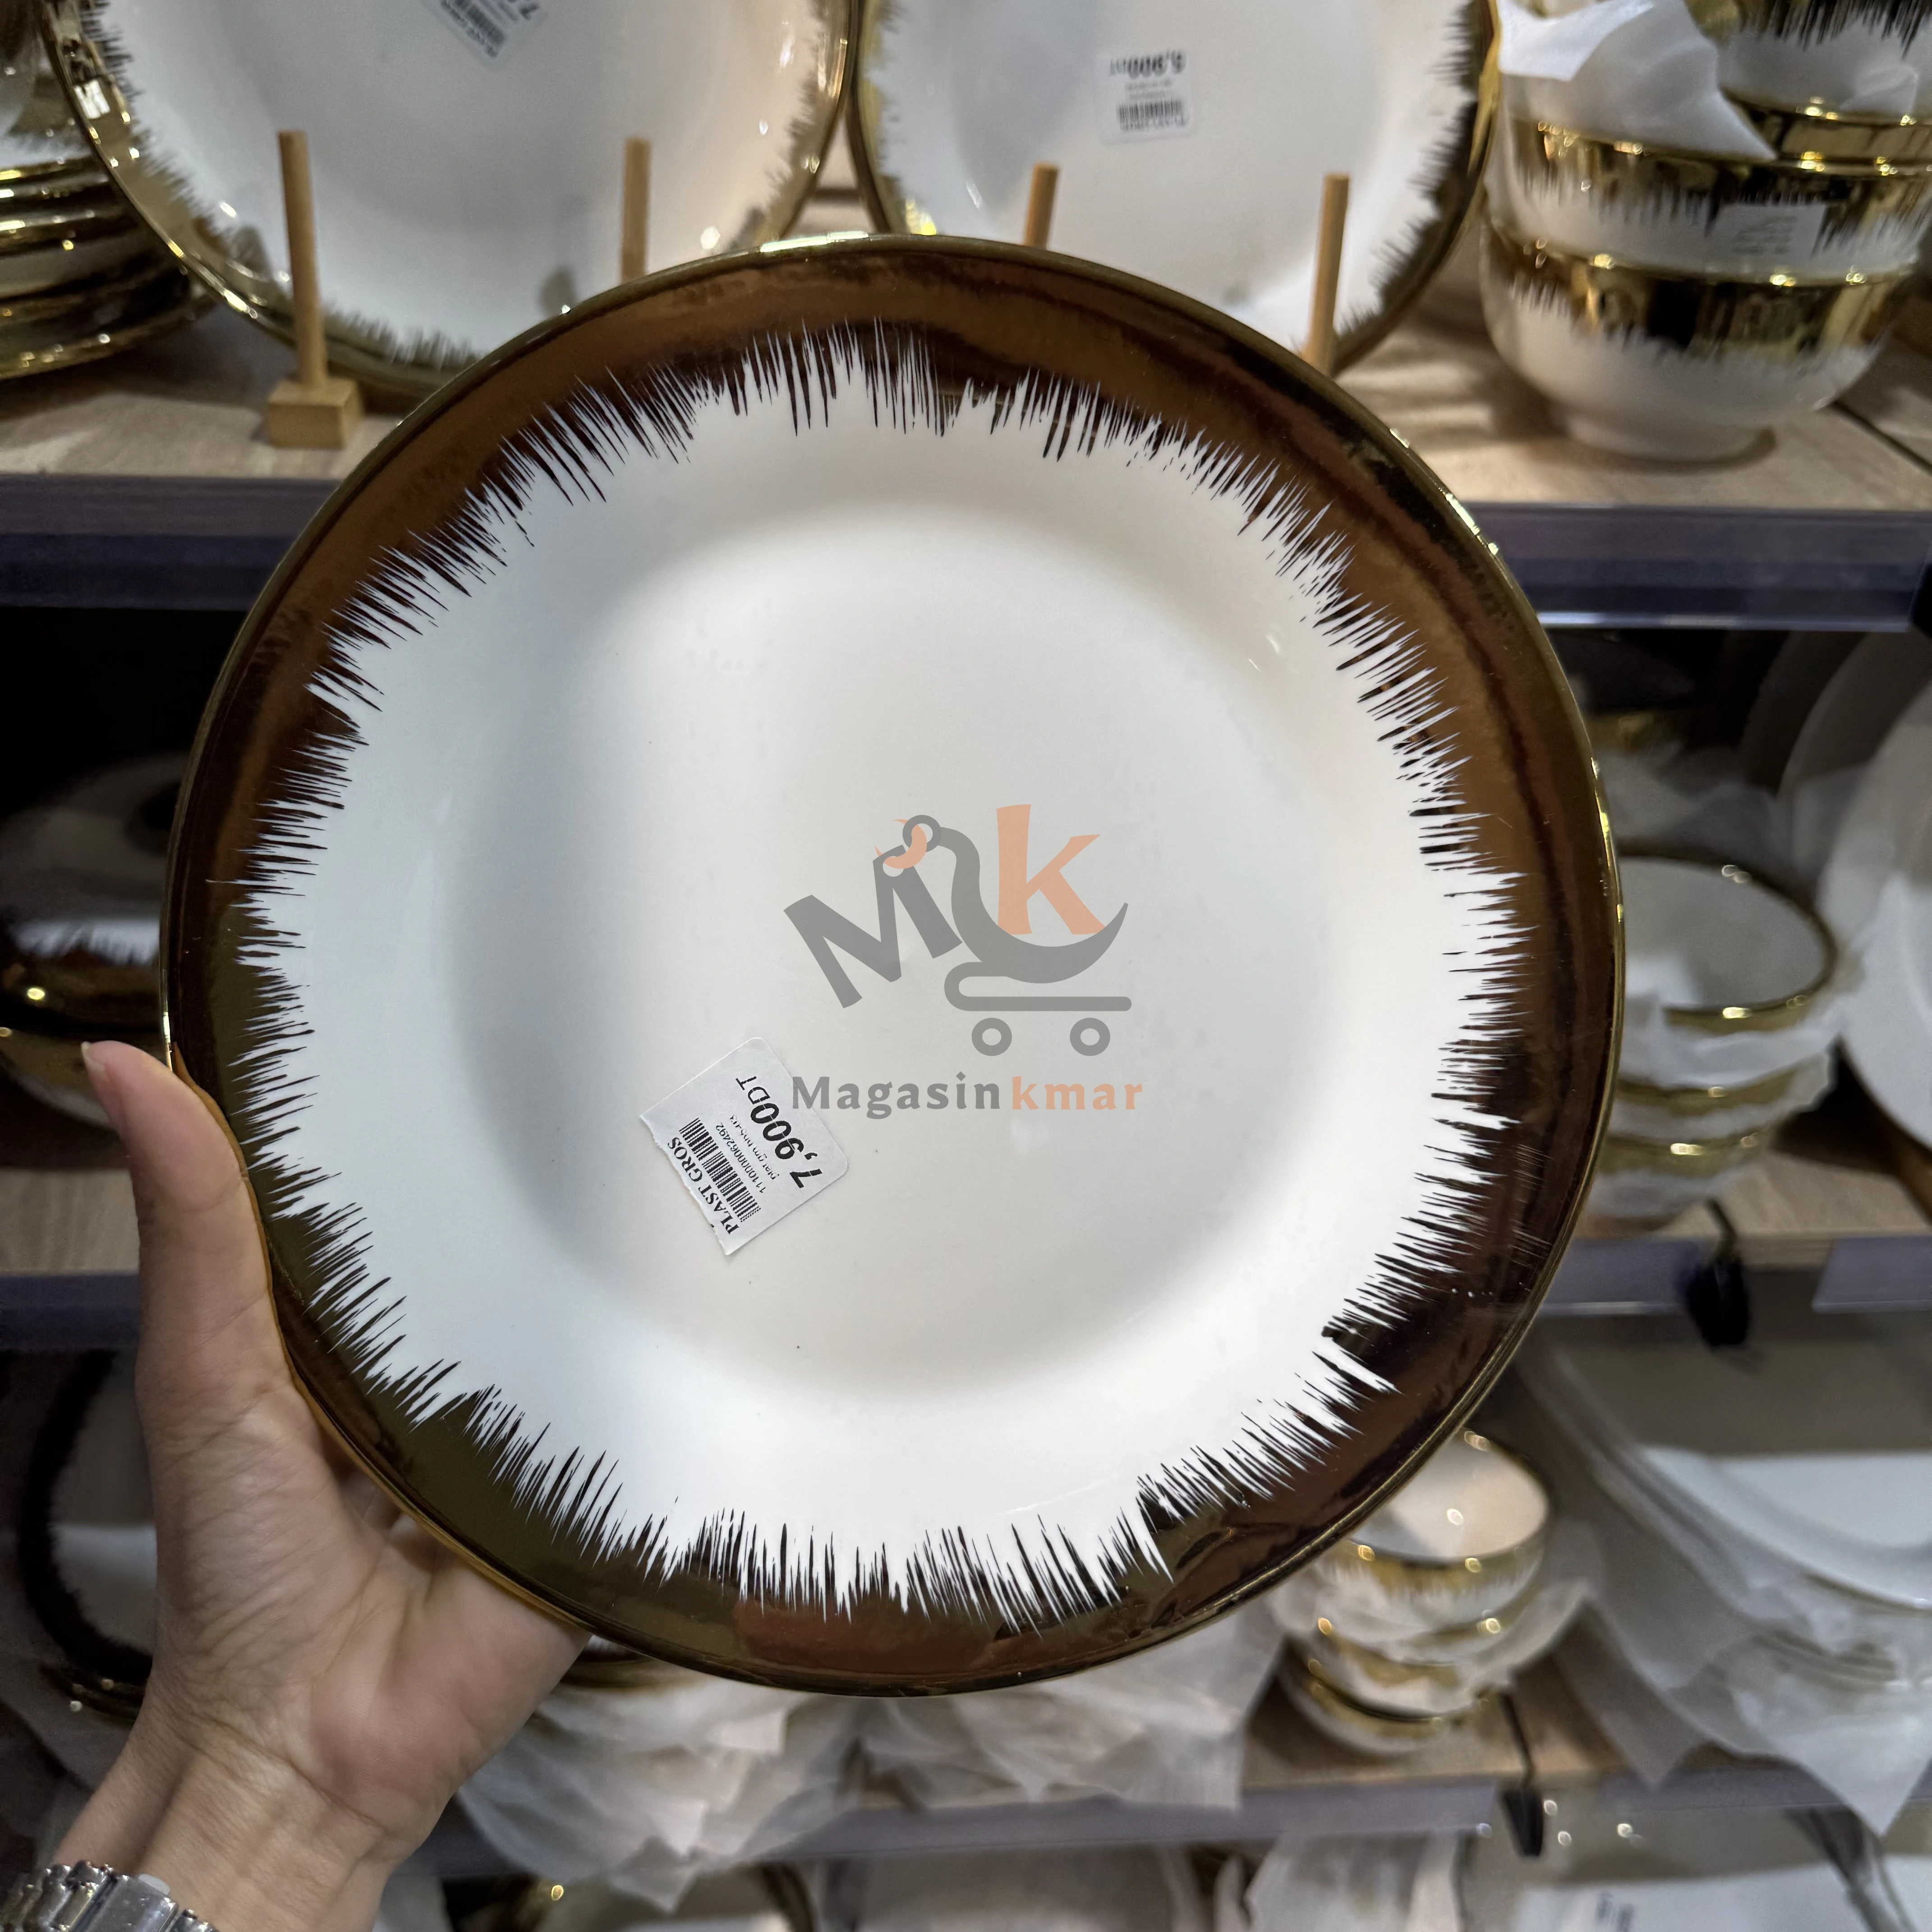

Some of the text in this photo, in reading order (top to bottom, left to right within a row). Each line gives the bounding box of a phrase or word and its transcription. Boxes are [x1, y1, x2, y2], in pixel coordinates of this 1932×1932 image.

[716, 1122, 766, 1193] 1110000062492
[736, 1076, 822, 1188] 7,900DT
[668, 1137, 739, 1234] PLAST GROS
